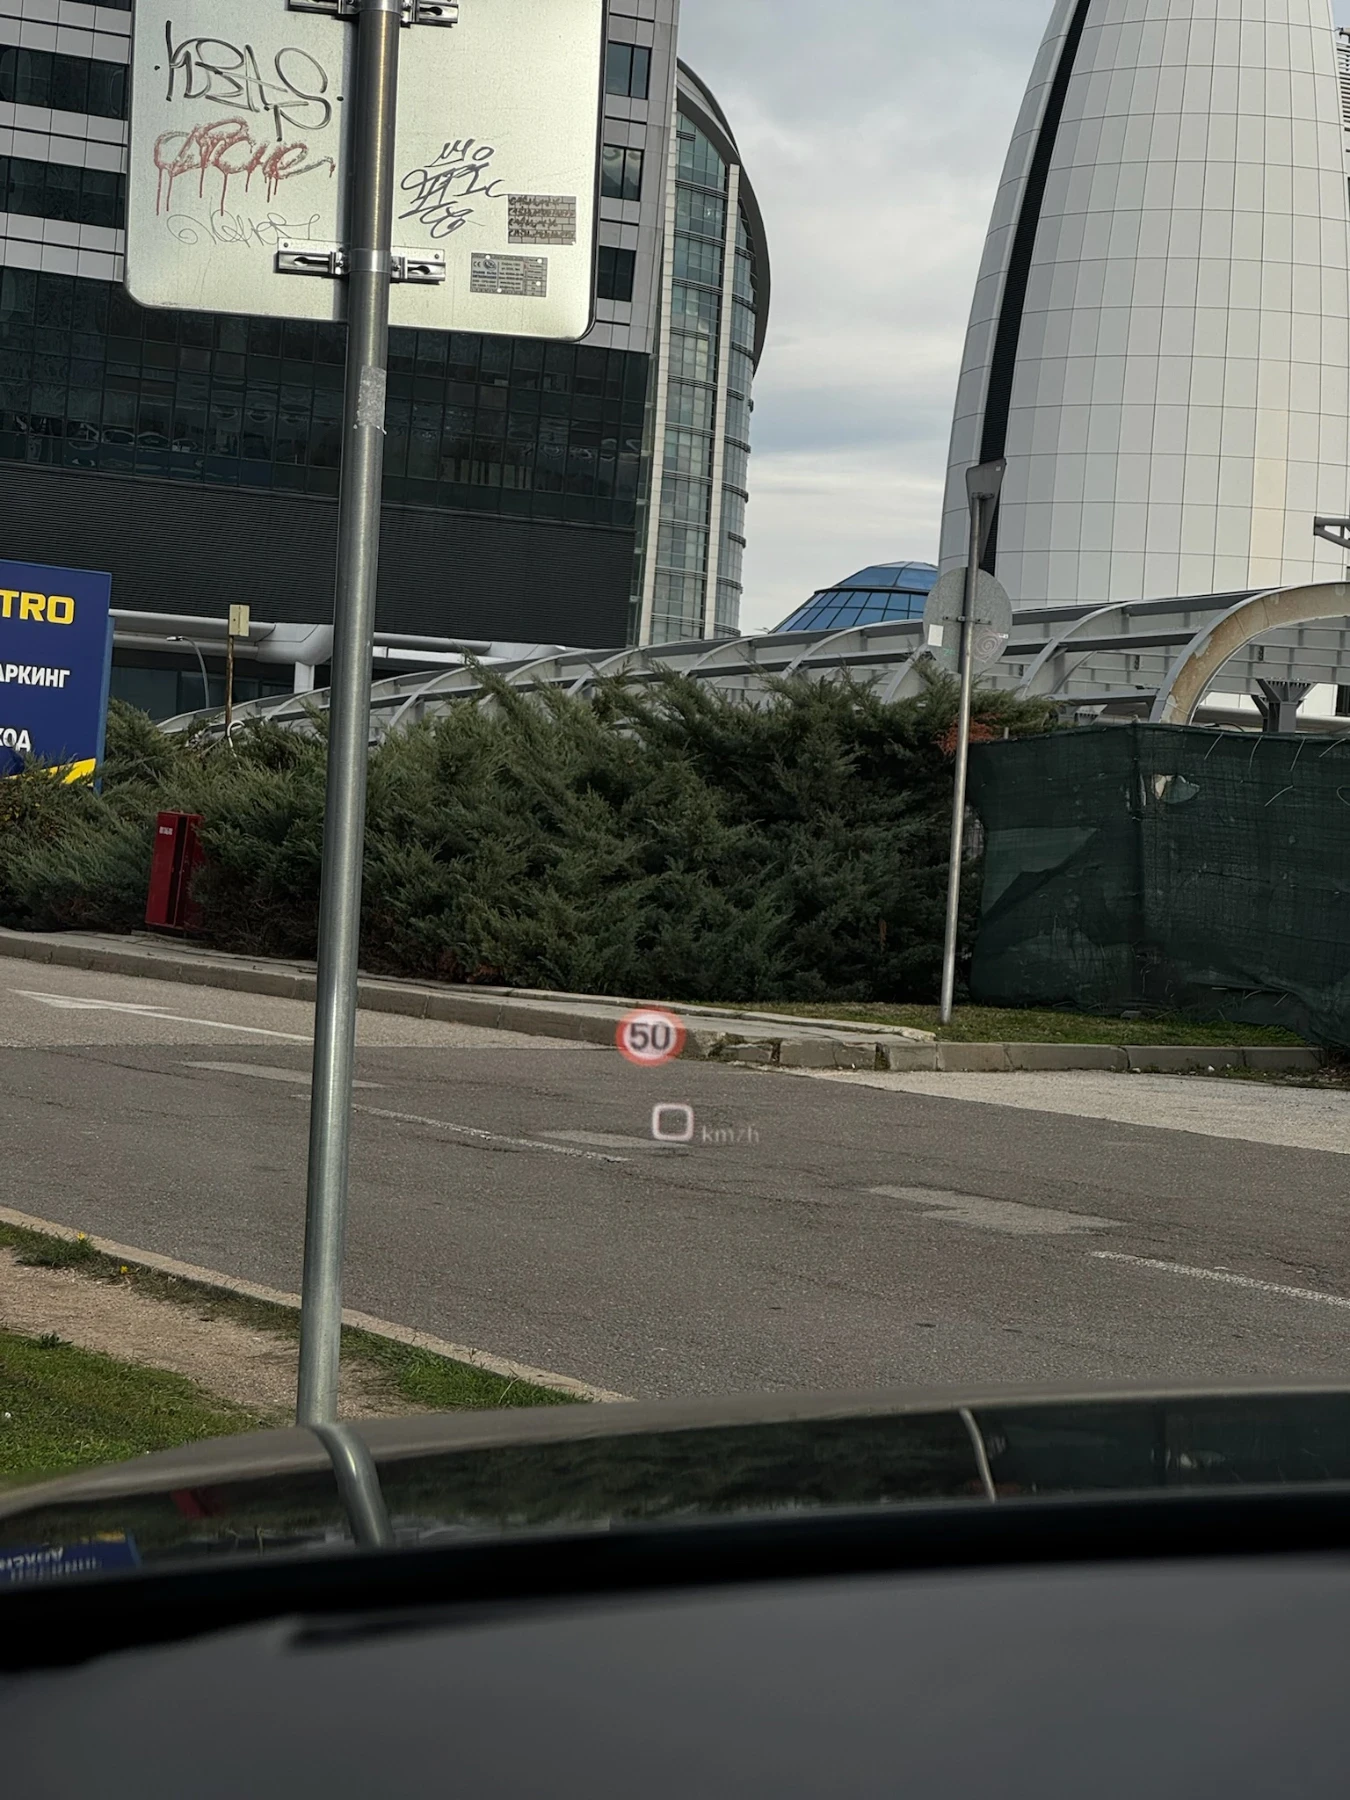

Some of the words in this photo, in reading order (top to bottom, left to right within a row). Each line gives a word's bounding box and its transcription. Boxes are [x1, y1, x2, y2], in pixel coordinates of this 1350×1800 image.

[629, 1022, 671, 1051] 50
[652, 1103, 693, 1141] 0
[702, 1125, 760, 1143] km/h
